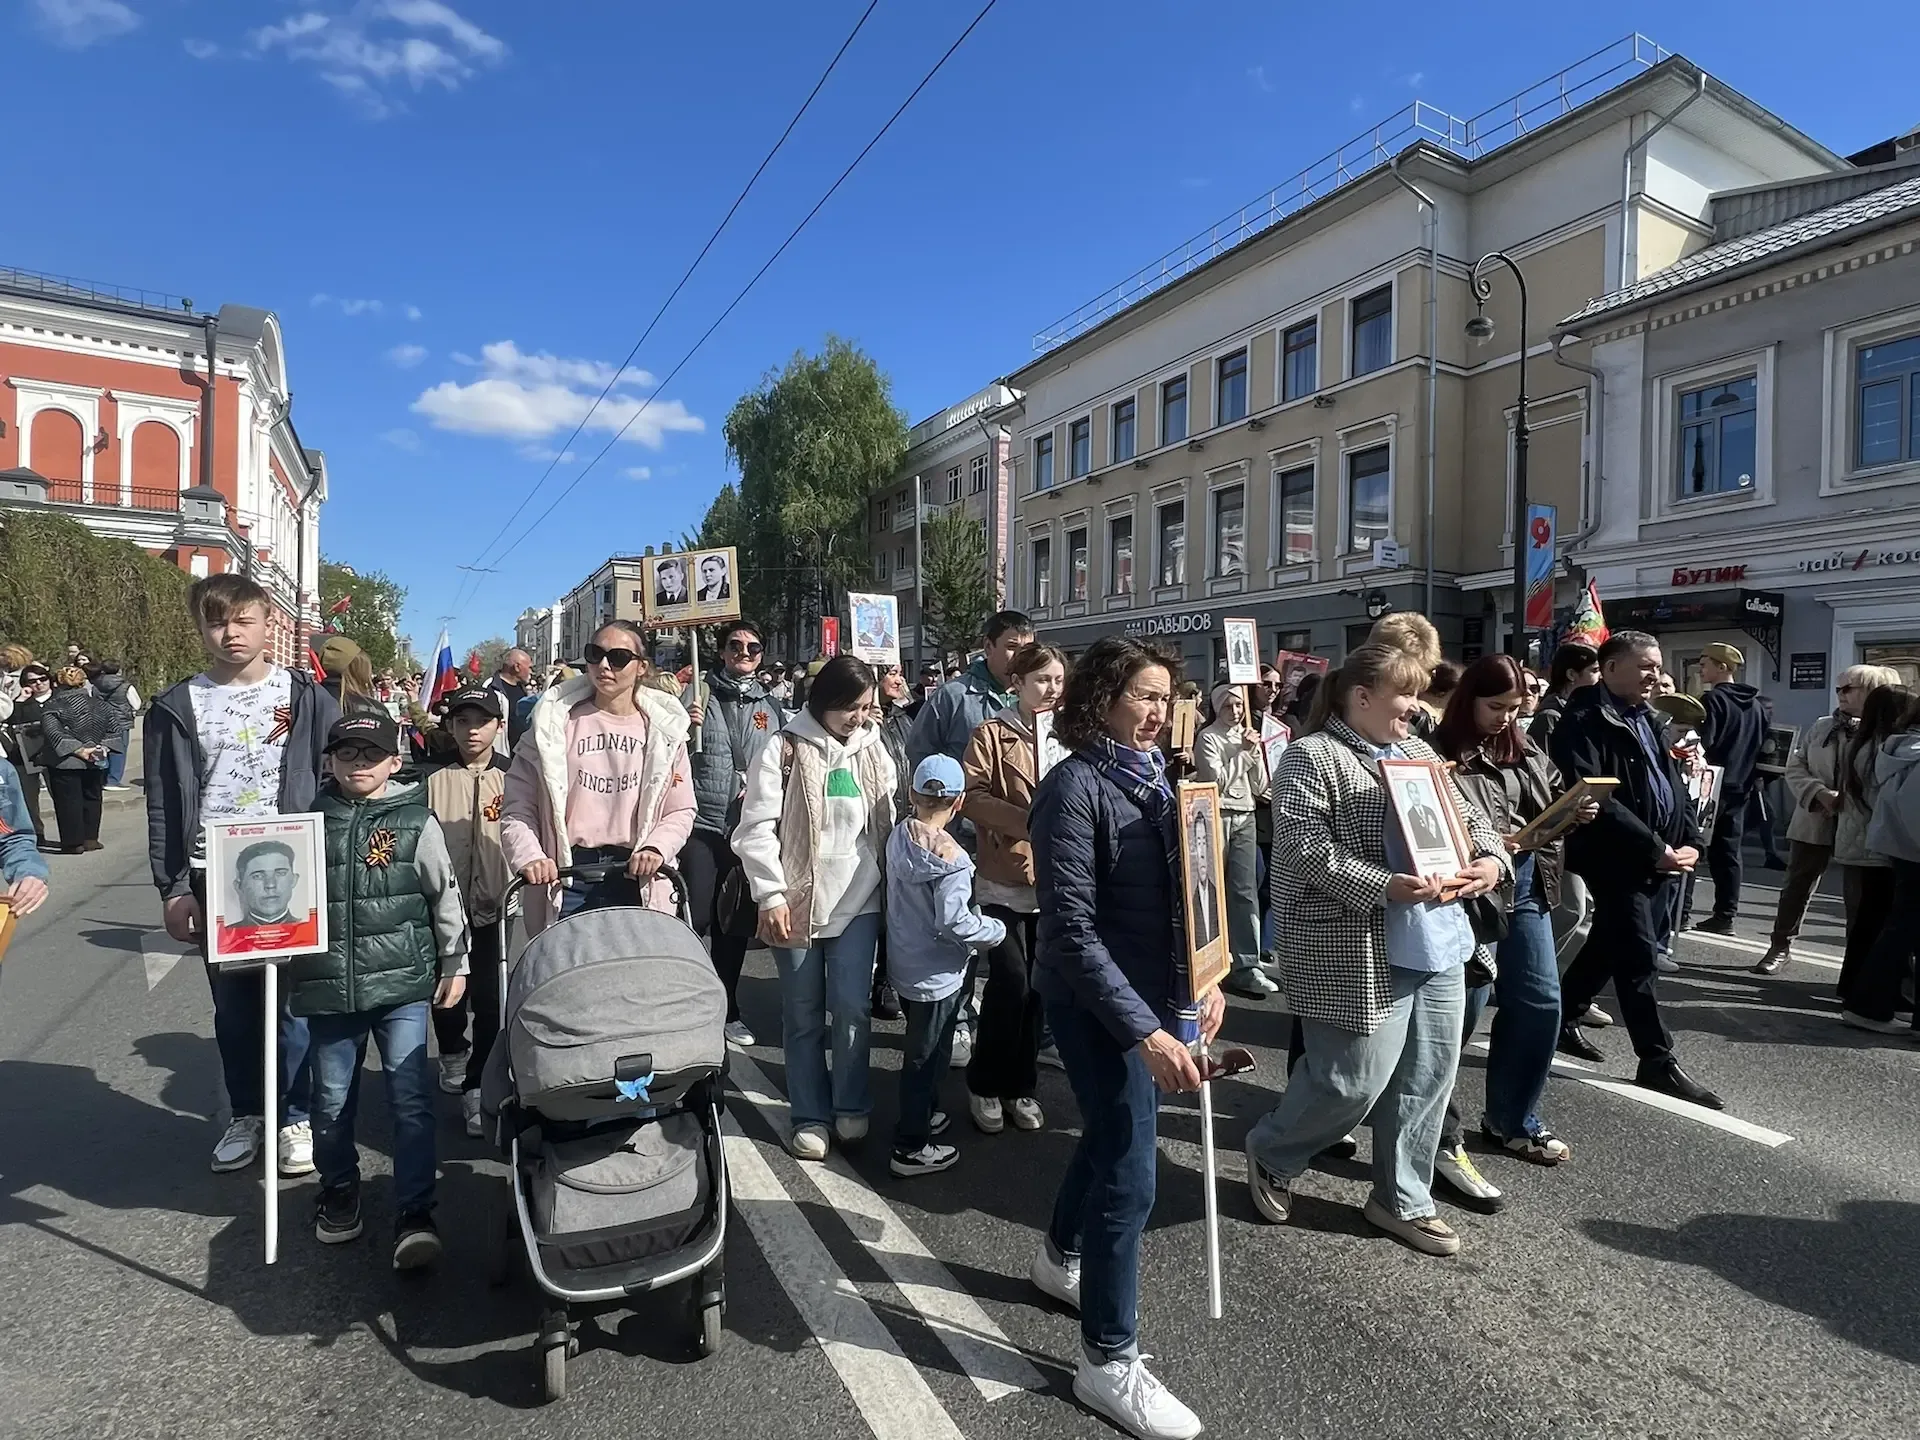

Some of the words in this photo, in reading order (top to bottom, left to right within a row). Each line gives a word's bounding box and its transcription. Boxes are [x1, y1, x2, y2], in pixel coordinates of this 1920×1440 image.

[1797, 551, 1844, 573] чай
[577, 733, 605, 756] OLD
[577, 769, 614, 794] SINCE
